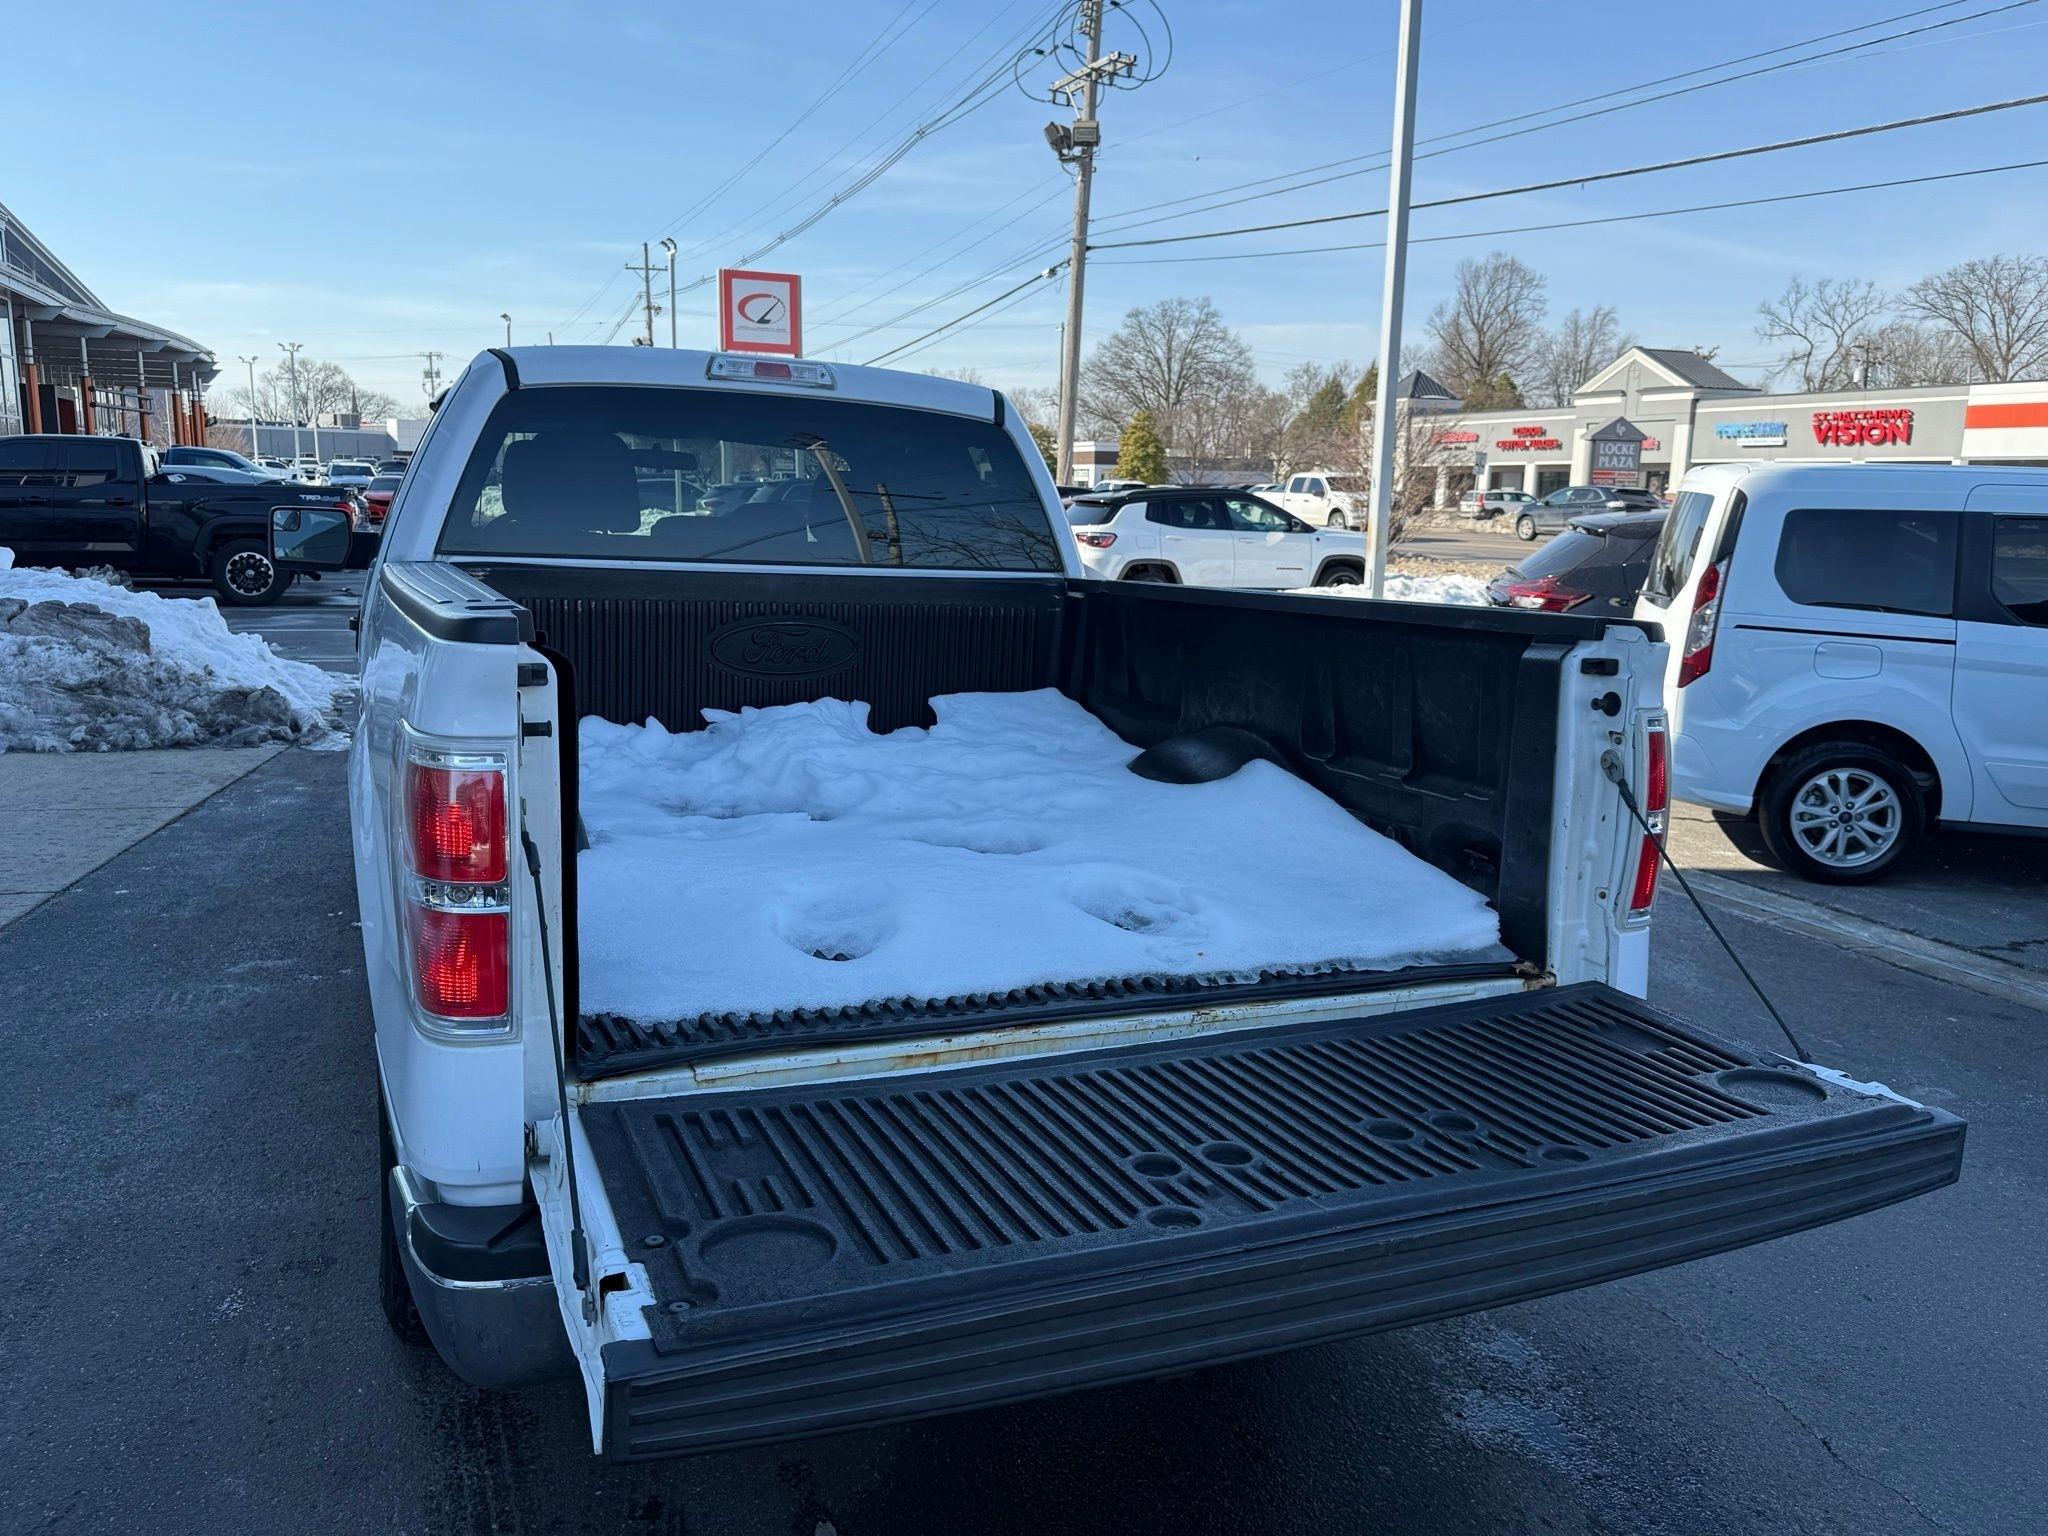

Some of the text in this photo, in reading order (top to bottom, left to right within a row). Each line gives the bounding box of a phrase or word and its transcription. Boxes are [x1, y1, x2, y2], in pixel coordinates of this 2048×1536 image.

[1832, 408, 1912, 421] MATTHEWS
[1813, 422, 1912, 445] VISION
[1599, 442, 1635, 455] LOCKE
[1598, 456, 1634, 468] PLAZA
[743, 627, 829, 664] Ford
